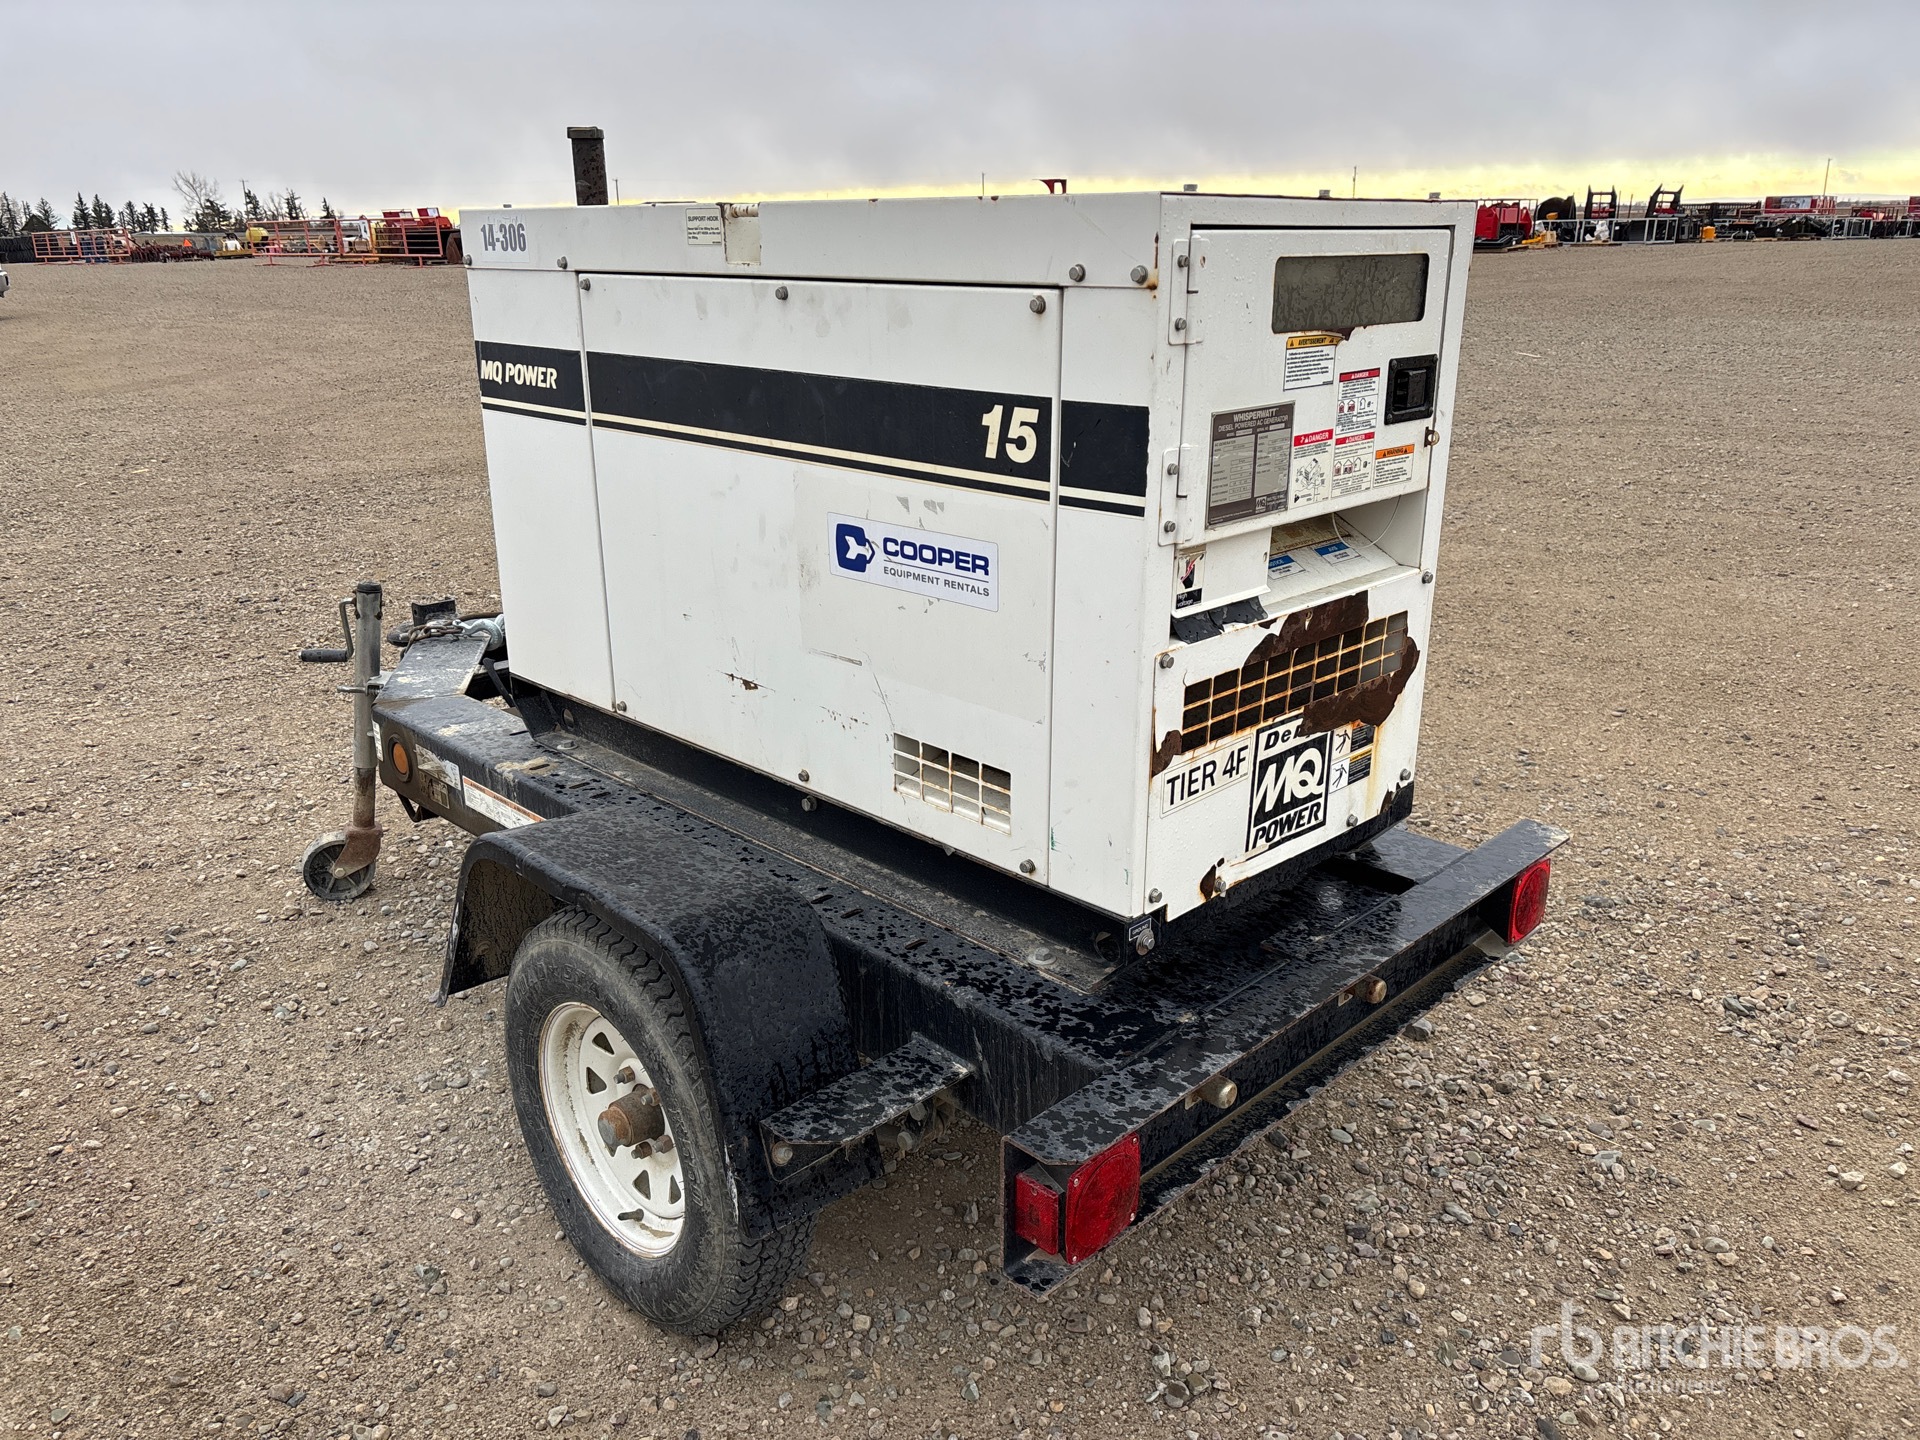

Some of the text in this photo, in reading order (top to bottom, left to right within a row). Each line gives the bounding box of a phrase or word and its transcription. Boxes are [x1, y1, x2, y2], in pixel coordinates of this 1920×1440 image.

[480, 222, 526, 252] 14-306
[480, 360, 557, 389] MQ POWER
[1234, 408, 1278, 422] WHISPERWATT
[1234, 421, 1256, 430] POWERED
[1264, 415, 1288, 424] GENERATOR
[982, 404, 1040, 464] 15
[1308, 432, 1329, 442] DANGER
[1386, 448, 1404, 456] WARNING
[883, 536, 989, 576] COOPER
[884, 566, 990, 597] EQUIPMENT RENTALS
[1177, 599, 1193, 607] voltage
[1166, 744, 1250, 806] TIER 4F
[1255, 748, 1324, 820] MQ
[1253, 802, 1322, 849] POWER
